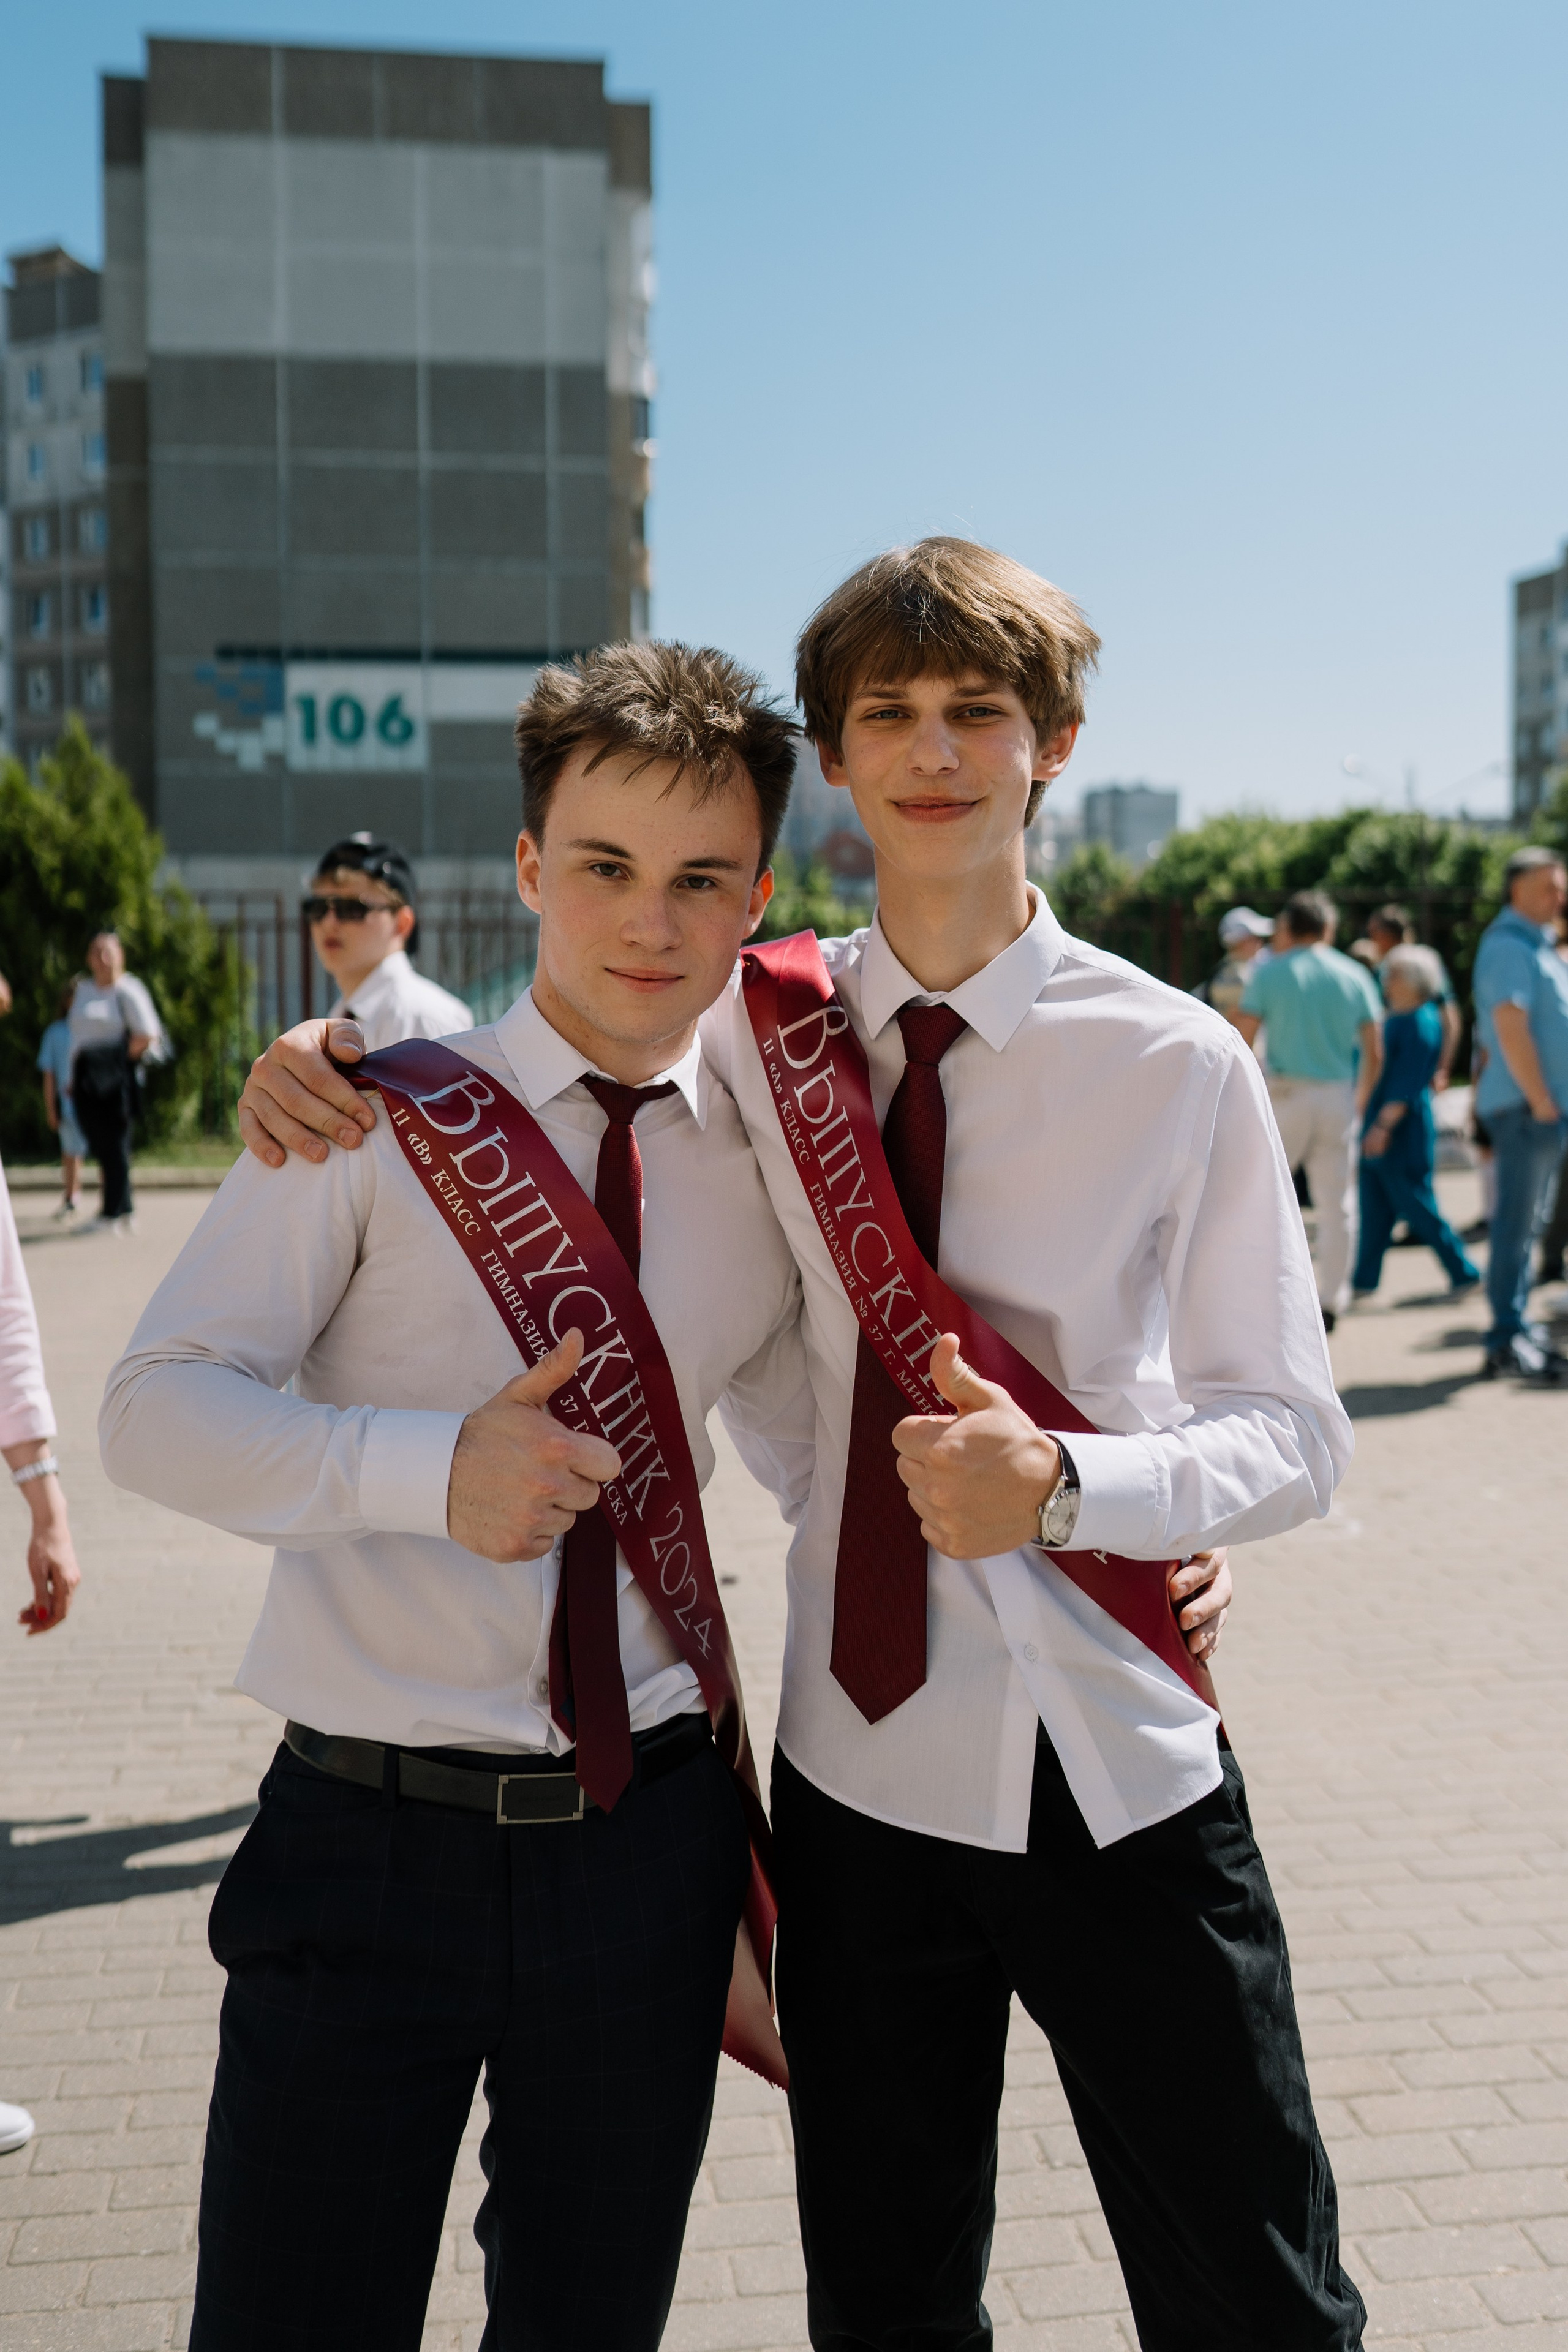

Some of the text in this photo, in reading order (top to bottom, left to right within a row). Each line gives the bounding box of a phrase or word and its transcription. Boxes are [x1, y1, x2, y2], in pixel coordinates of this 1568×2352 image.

[296, 690, 415, 747] 106
[391, 1107, 411, 1127] 11
[407, 1133, 433, 1165] «В»
[431, 1168, 481, 1236] КЛАСС
[480, 1248, 550, 1362] ГИМНАЗИЯ
[560, 1394, 579, 1413] 37
[763, 1038, 775, 1056] 11
[769, 1062, 782, 1094] «А»
[780, 1098, 810, 1164] КЛАСС
[809, 1181, 858, 1292] ГИМНАЗИЯ
[855, 1295, 869, 1319] №
[869, 1324, 884, 1341] 37
[777, 1005, 981, 1417] ВЫПУСКН
[407, 1070, 712, 1660] ВЫПУСКНИК 2024
